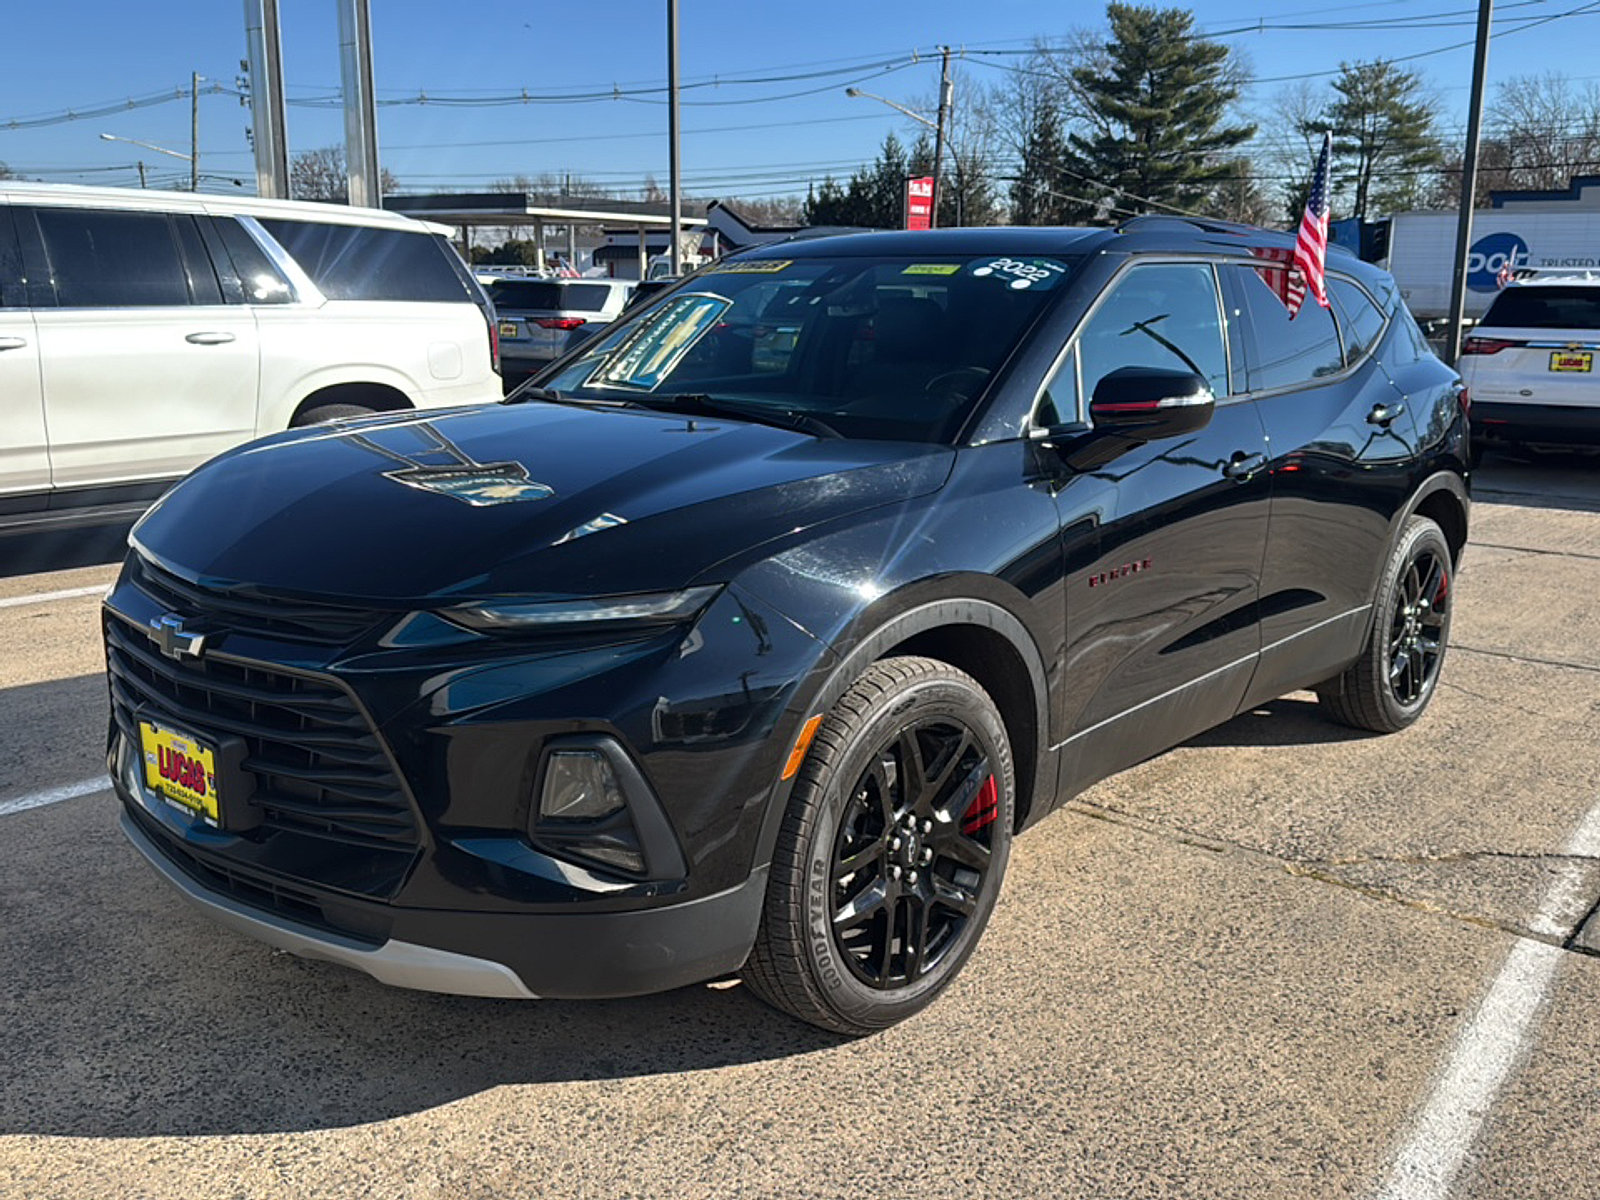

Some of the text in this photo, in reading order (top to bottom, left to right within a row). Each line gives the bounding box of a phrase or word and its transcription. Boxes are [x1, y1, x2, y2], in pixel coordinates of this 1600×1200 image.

[988, 257, 1050, 282] 2022
[1540, 258, 1595, 267] TRUSTED
[157, 743, 206, 796] LUCAS
[810, 859, 842, 991] GOODYEAR
